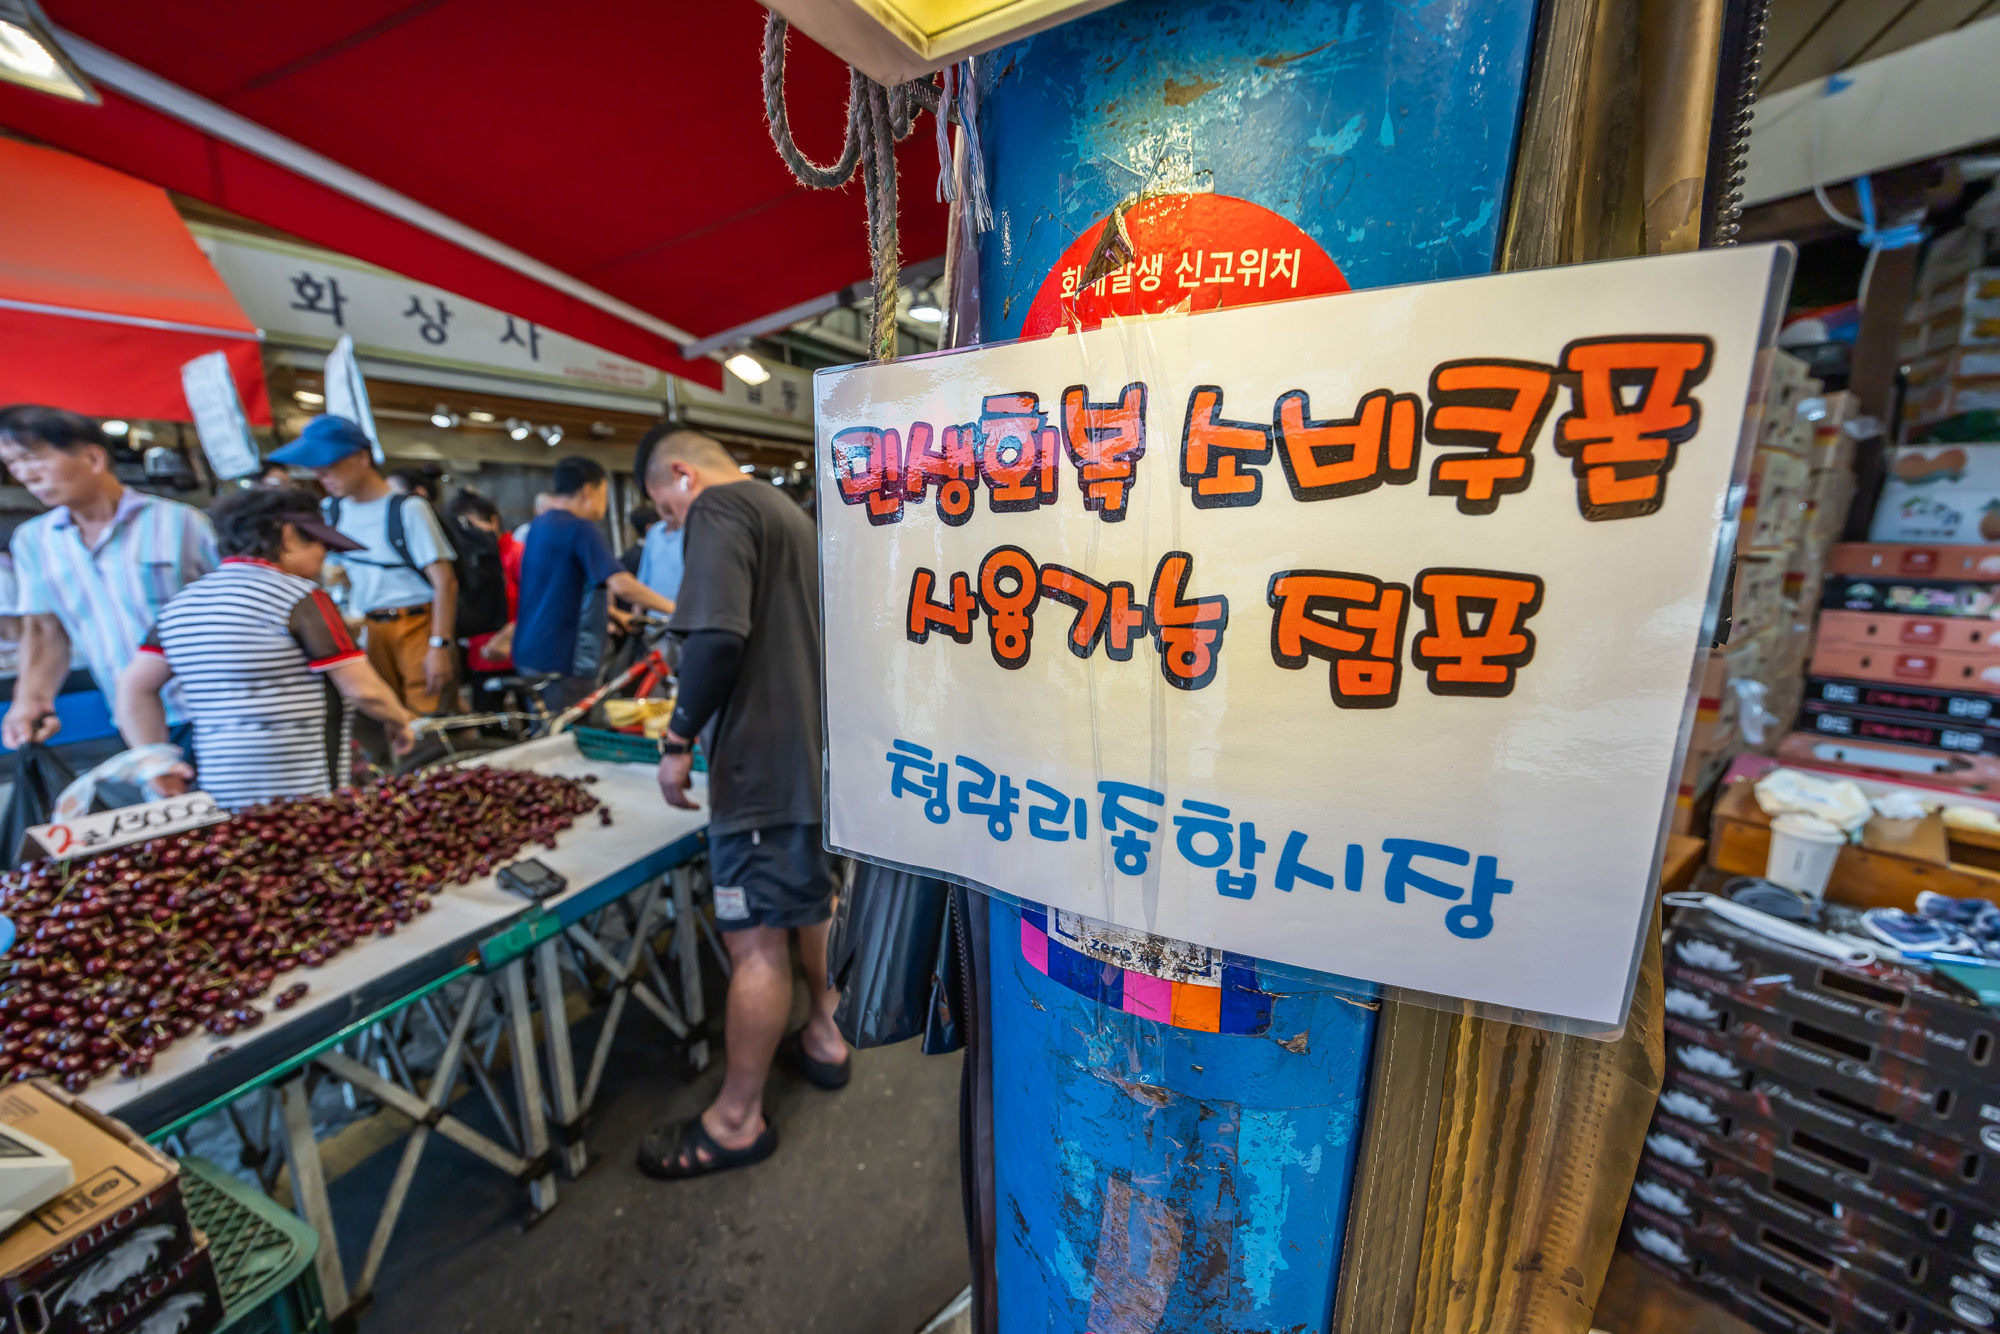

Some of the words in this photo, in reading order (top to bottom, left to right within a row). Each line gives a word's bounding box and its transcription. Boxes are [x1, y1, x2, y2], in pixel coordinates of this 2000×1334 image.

[1174, 247, 1301, 288] 신고위치
[831, 381, 1148, 527] 민생회복
[1179, 334, 1714, 522] 소비쿠폰
[906, 544, 1229, 690] 사용가능
[1267, 567, 1544, 709] 점포
[886, 739, 1514, 939] 청량리종합시장
